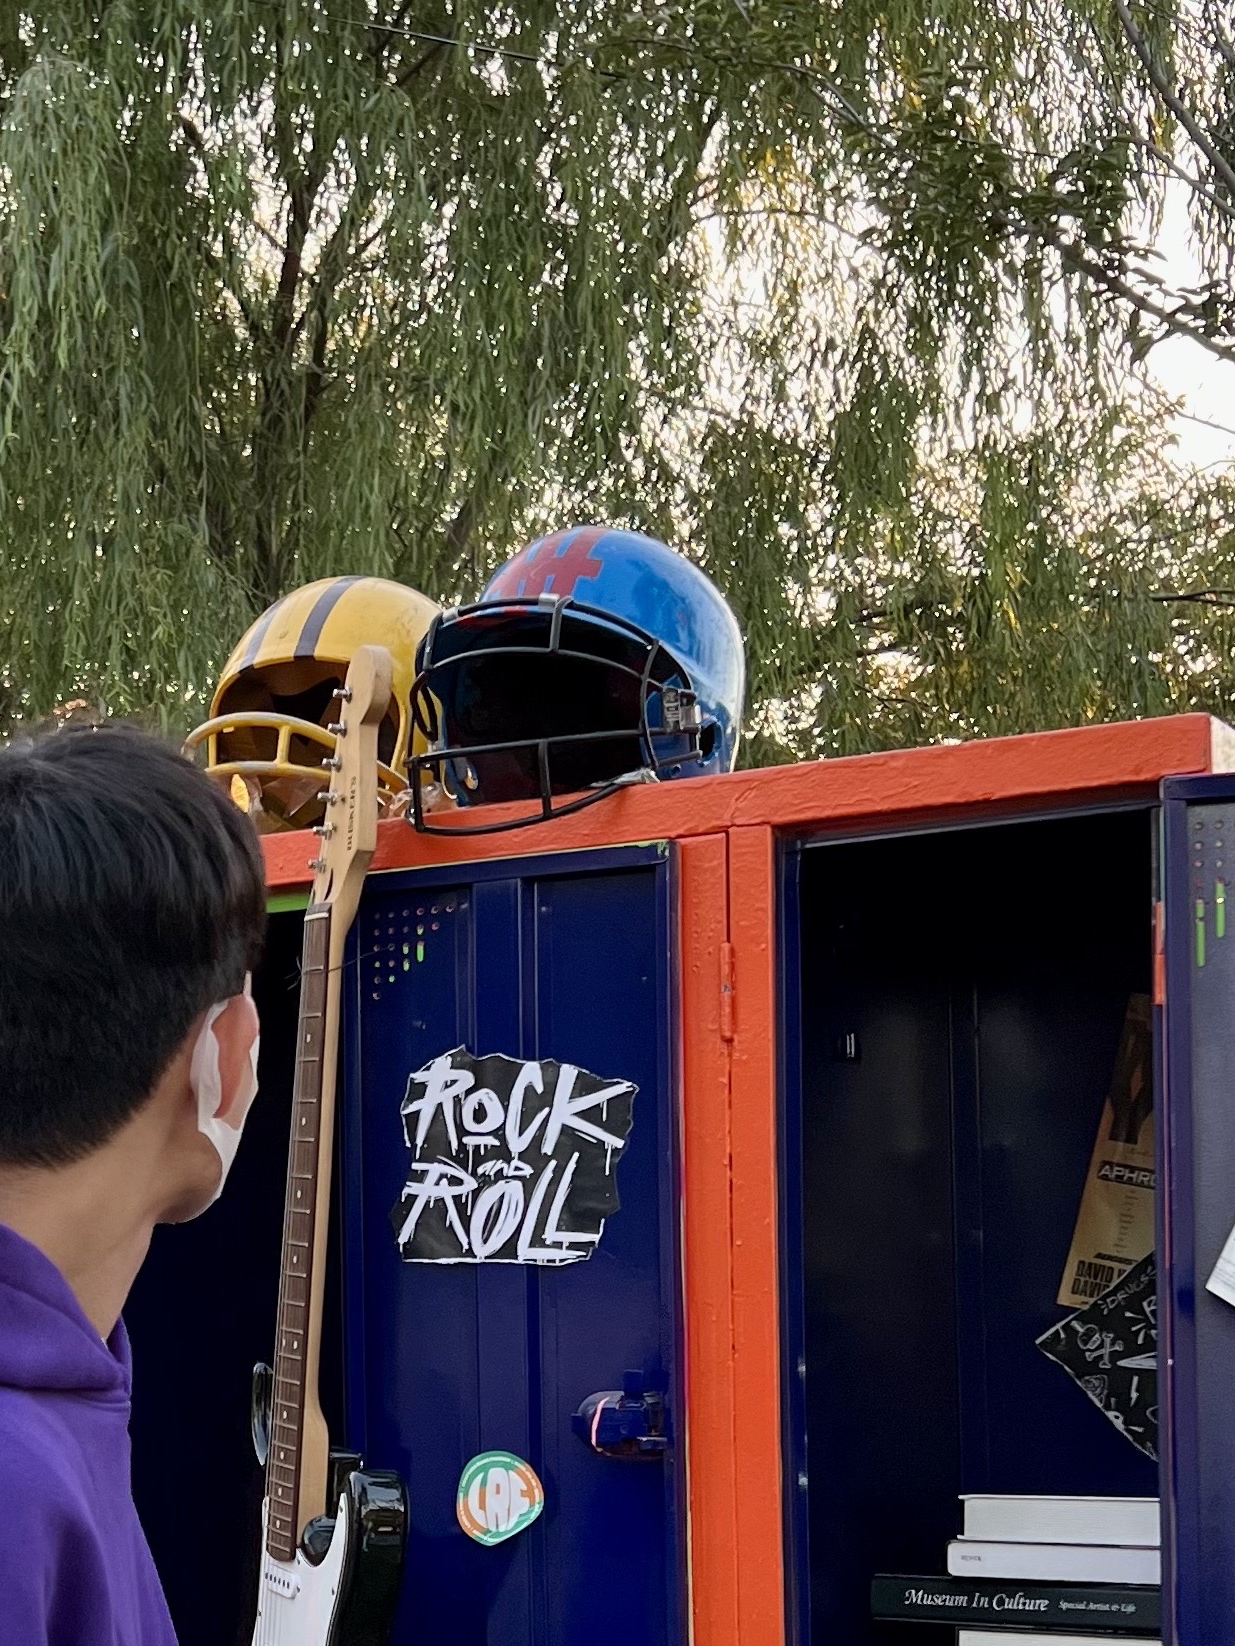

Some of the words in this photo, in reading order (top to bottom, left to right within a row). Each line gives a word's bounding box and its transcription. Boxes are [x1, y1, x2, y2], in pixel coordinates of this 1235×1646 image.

[904, 1588, 967, 1607] Museum
[971, 1593, 989, 1609] In
[992, 1593, 1049, 1611] Culture
